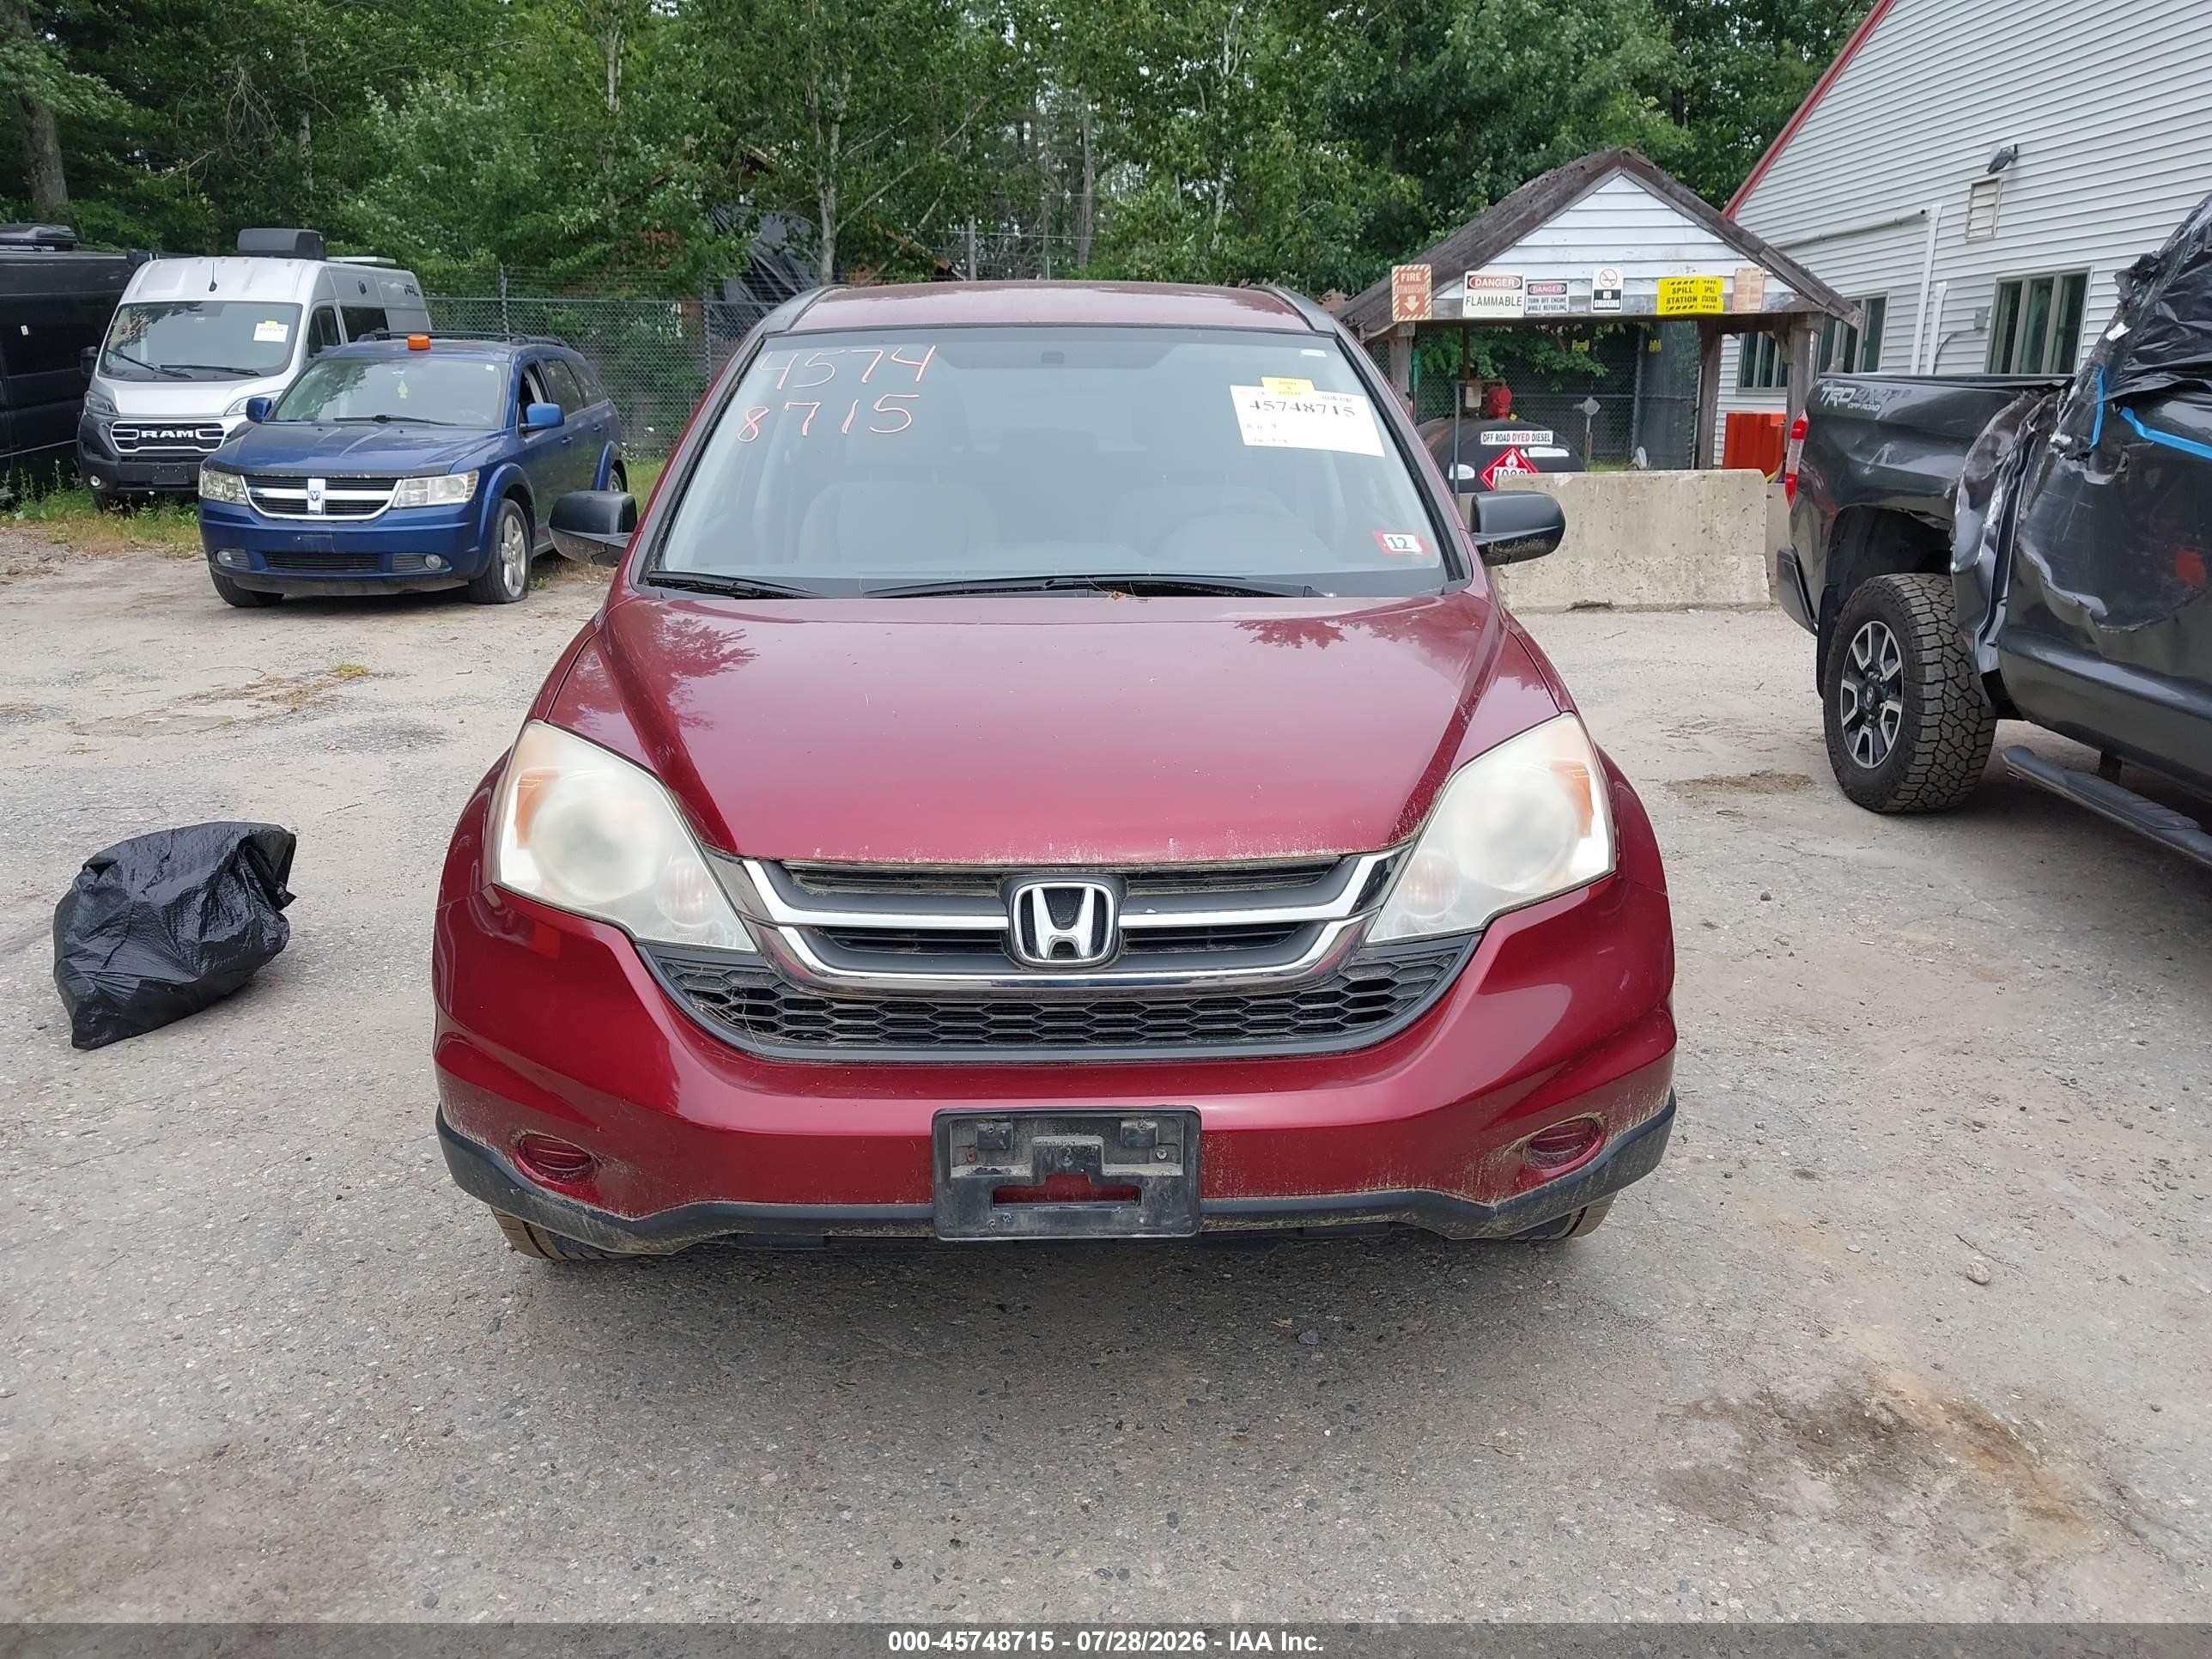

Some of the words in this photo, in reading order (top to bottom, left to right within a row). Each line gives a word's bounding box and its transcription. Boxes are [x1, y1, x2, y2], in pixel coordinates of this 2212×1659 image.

[1401, 271, 1423, 283] FIRE
[1474, 277, 1516, 289] DANGER
[1532, 284, 1562, 294] DANGER
[1671, 286, 1693, 295] SPILL
[1704, 285, 1716, 294] SPILL
[1601, 290, 1613, 300] NO
[1666, 295, 1698, 305] STATION
[1466, 295, 1523, 307] FLAMMABLE
[1593, 299, 1620, 309] SMOKING
[757, 345, 937, 391] 4574
[1820, 386, 1856, 407] TRD
[1249, 400, 1356, 417] 45748715
[736, 394, 921, 443] 8715
[141, 429, 195, 439] RAM
[1482, 432, 1494, 442] OFF
[1495, 432, 1510, 442] ROAD
[1511, 432, 1529, 442] DYED
[1531, 432, 1552, 442] DIESEL
[1387, 536, 1413, 550] 12
